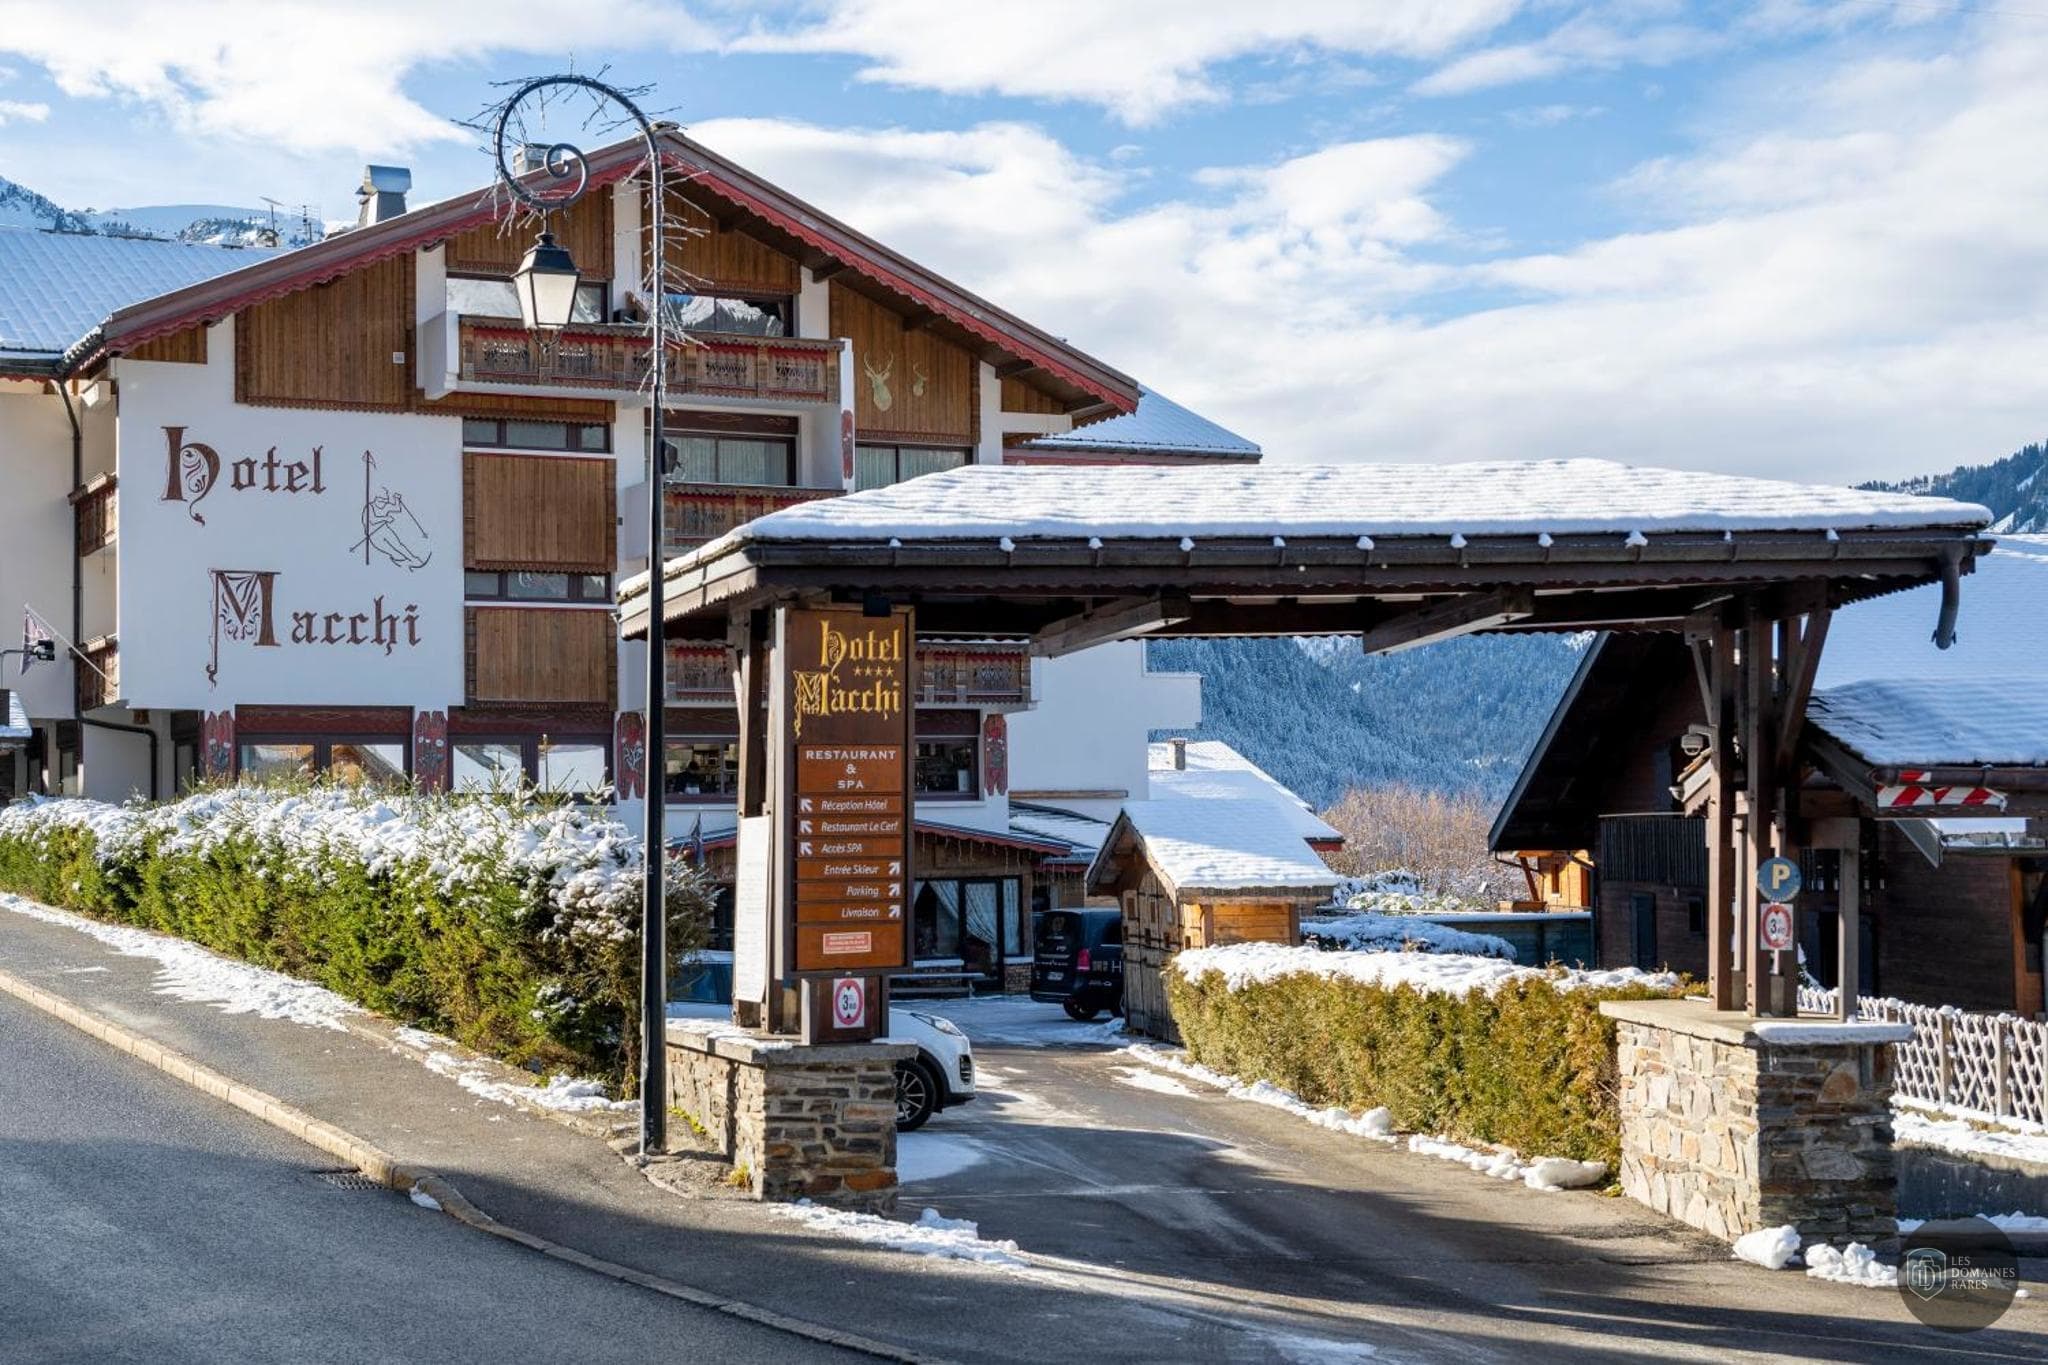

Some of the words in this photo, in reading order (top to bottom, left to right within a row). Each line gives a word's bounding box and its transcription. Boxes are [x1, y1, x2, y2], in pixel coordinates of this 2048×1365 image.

[161, 426, 327, 526] Hotel
[206, 568, 421, 687] Macchi
[820, 620, 901, 683] Hotel
[794, 670, 901, 738] Macchi
[806, 750, 896, 760] RESTAURANT
[846, 763, 857, 775] &
[838, 780, 864, 789] SPA
[821, 800, 863, 812] Réception
[864, 799, 888, 811] Hôtel
[821, 821, 867, 832] Restaurant
[869, 821, 878, 831] Le
[880, 821, 898, 832] Cerf
[847, 843, 862, 852] SPA
[824, 864, 851, 875] Entrée
[853, 864, 879, 874] Skieur
[1772, 864, 1790, 889] P
[846, 886, 879, 897] Parking
[841, 908, 879, 918] Livraison
